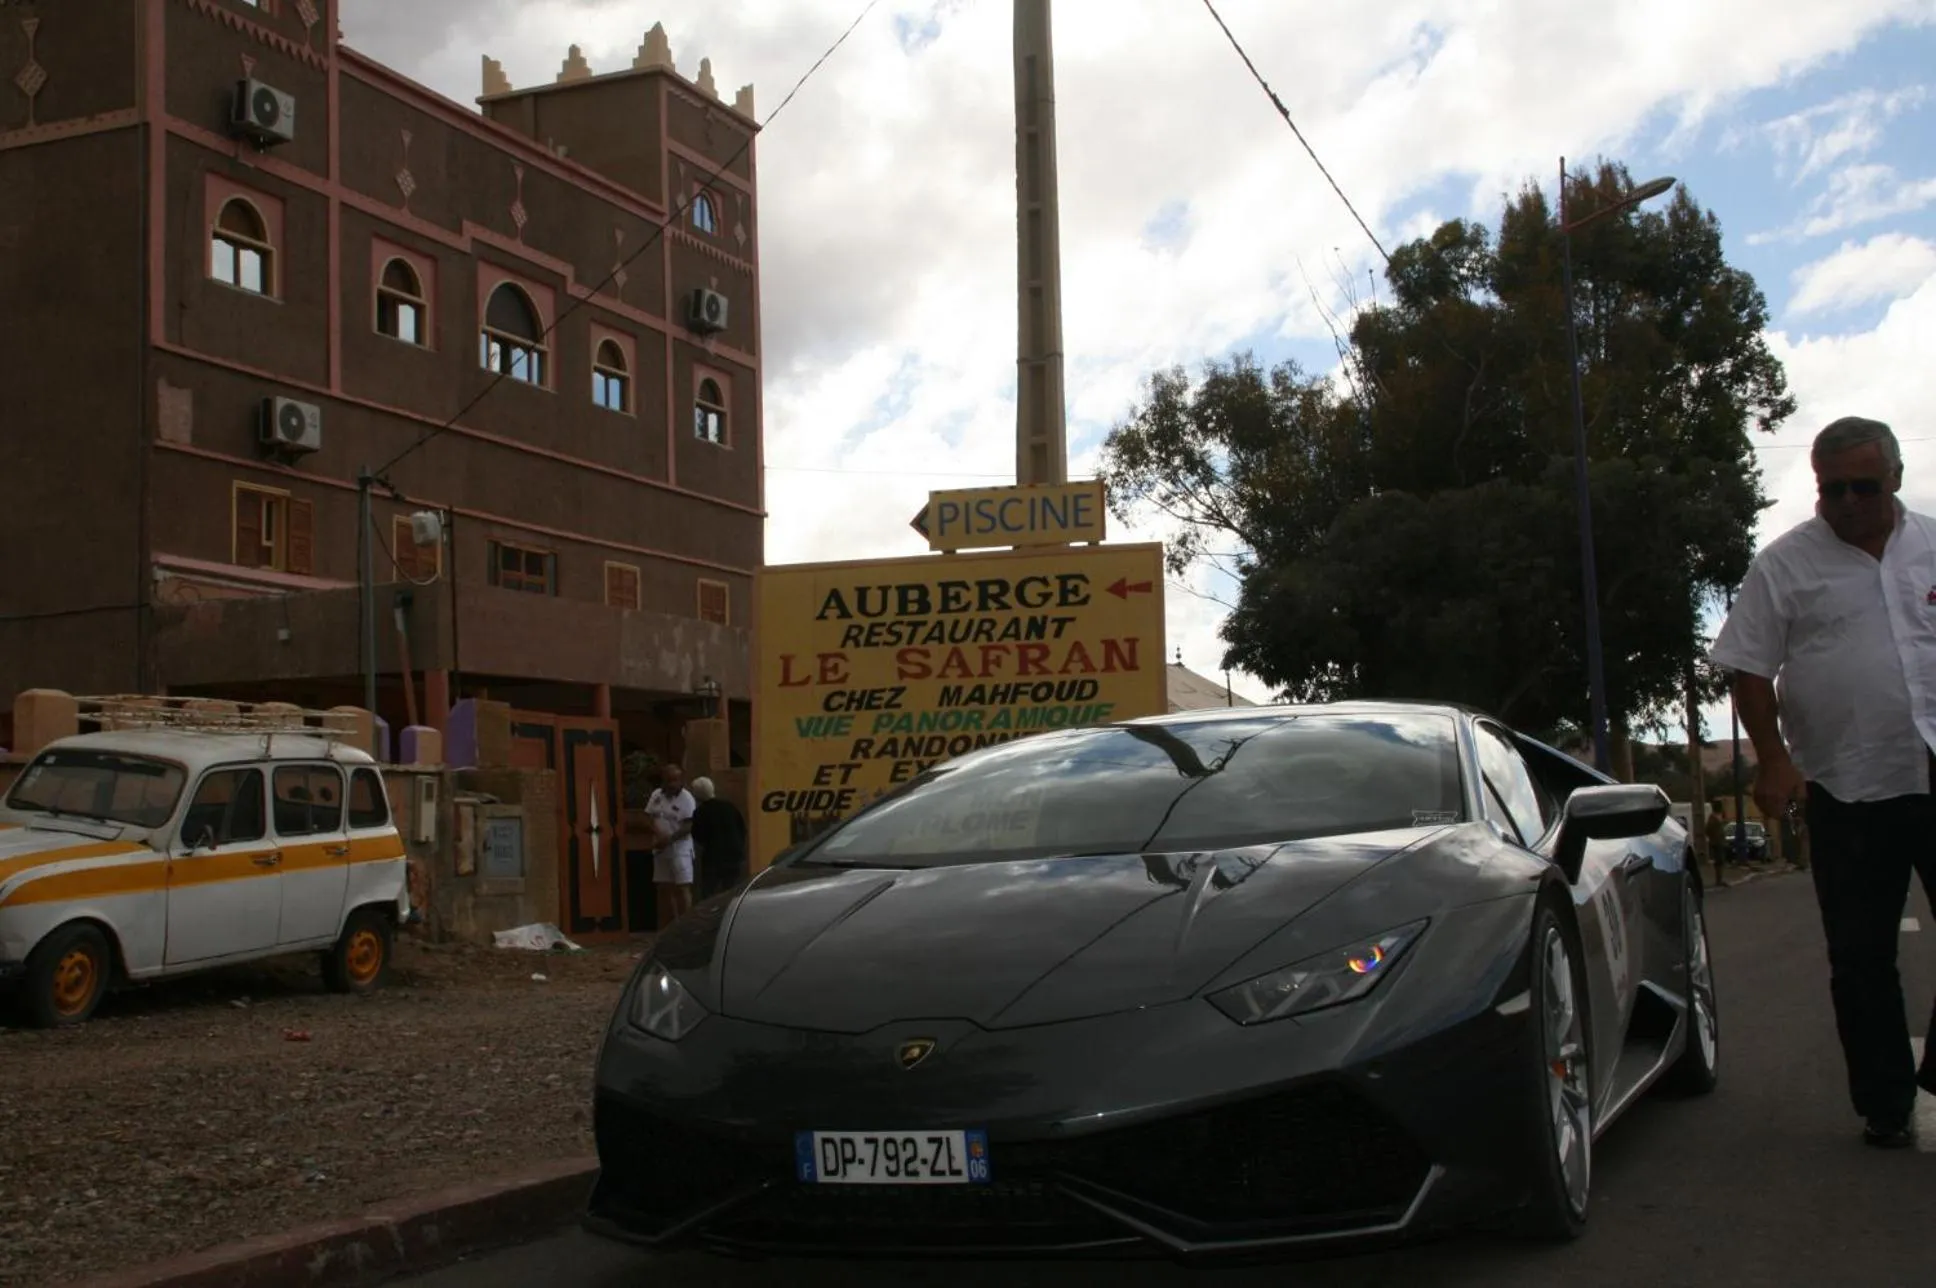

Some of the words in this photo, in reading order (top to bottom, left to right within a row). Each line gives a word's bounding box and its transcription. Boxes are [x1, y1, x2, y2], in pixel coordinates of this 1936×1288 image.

[938, 493, 1094, 536] PISCINE
[815, 573, 1091, 621] AUBERGE
[840, 615, 1076, 649] RESTAURANT
[777, 652, 850, 688] LE
[896, 637, 1141, 681] SAFRAN
[823, 685, 906, 713] CHEZ
[938, 679, 1099, 708] MAHFOUD
[795, 714, 854, 738] VUE
[812, 763, 862, 786] ET
[761, 788, 857, 812] GUIDE
[821, 1136, 963, 1178] DP-792-ZL
[970, 1159, 987, 1178] 06
